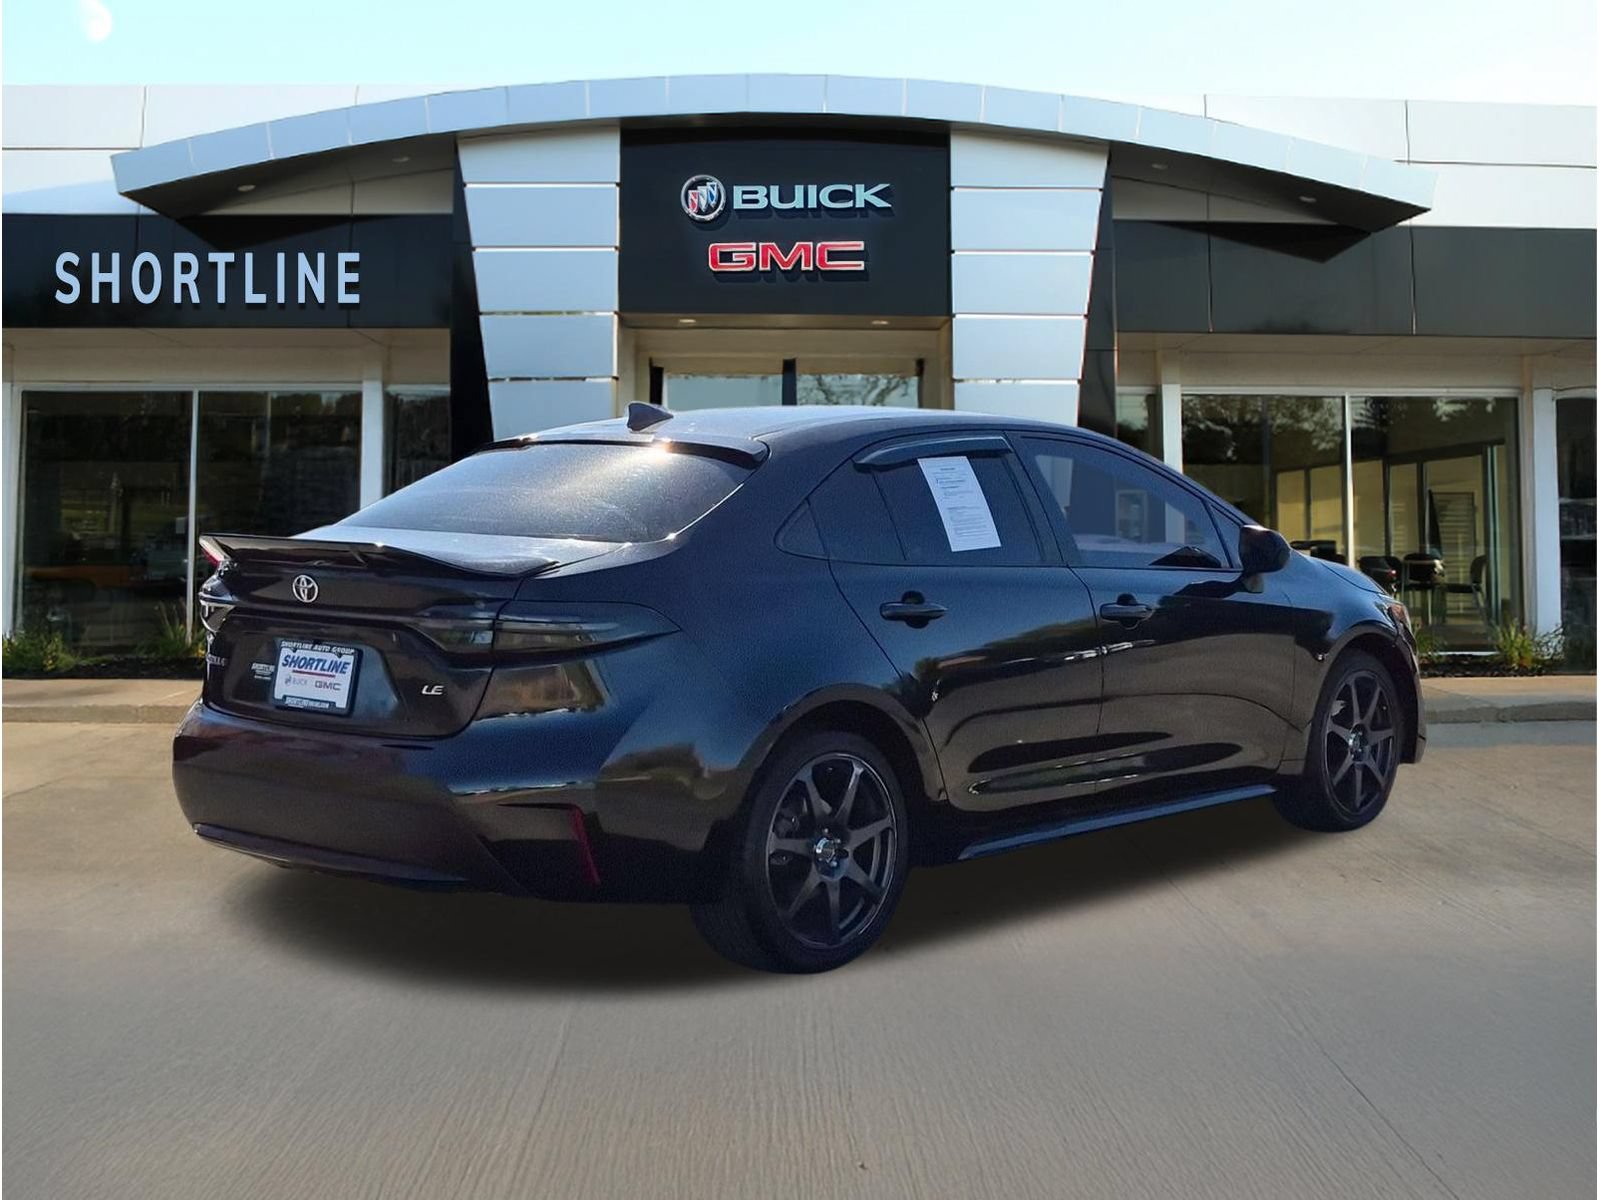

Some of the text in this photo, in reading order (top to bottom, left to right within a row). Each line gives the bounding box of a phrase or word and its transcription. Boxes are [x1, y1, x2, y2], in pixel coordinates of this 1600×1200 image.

[733, 183, 893, 210] BUICK
[708, 240, 865, 271] GMC
[55, 252, 361, 304] SHORTLINE
[313, 644, 330, 652] AUTO
[282, 654, 351, 674] SHORTLINE
[315, 680, 342, 691] GMC
[421, 685, 444, 695] LE
